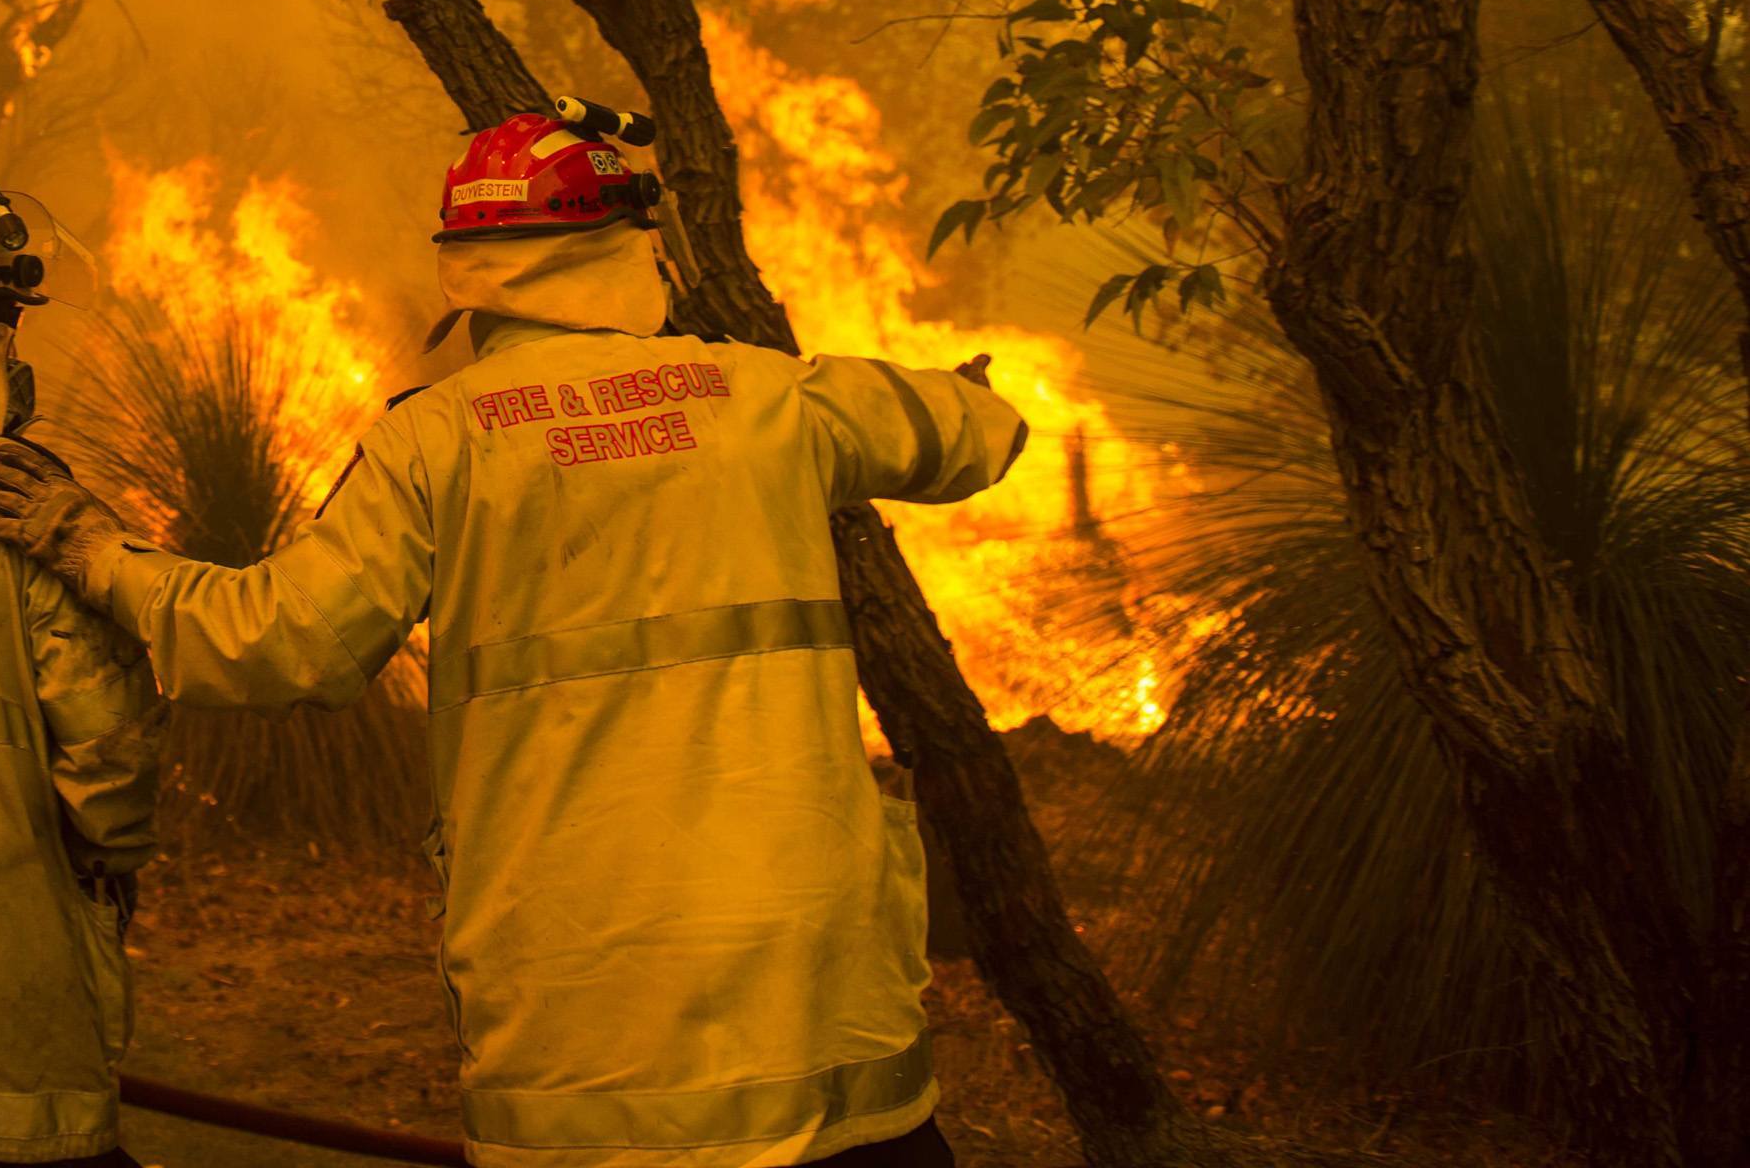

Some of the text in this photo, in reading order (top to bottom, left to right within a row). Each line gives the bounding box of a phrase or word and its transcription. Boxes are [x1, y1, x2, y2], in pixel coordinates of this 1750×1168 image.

[453, 183, 523, 202] DUYVESTEIN
[473, 363, 730, 430] FIRE & RESCUE
[546, 412, 697, 466] SERVICE
